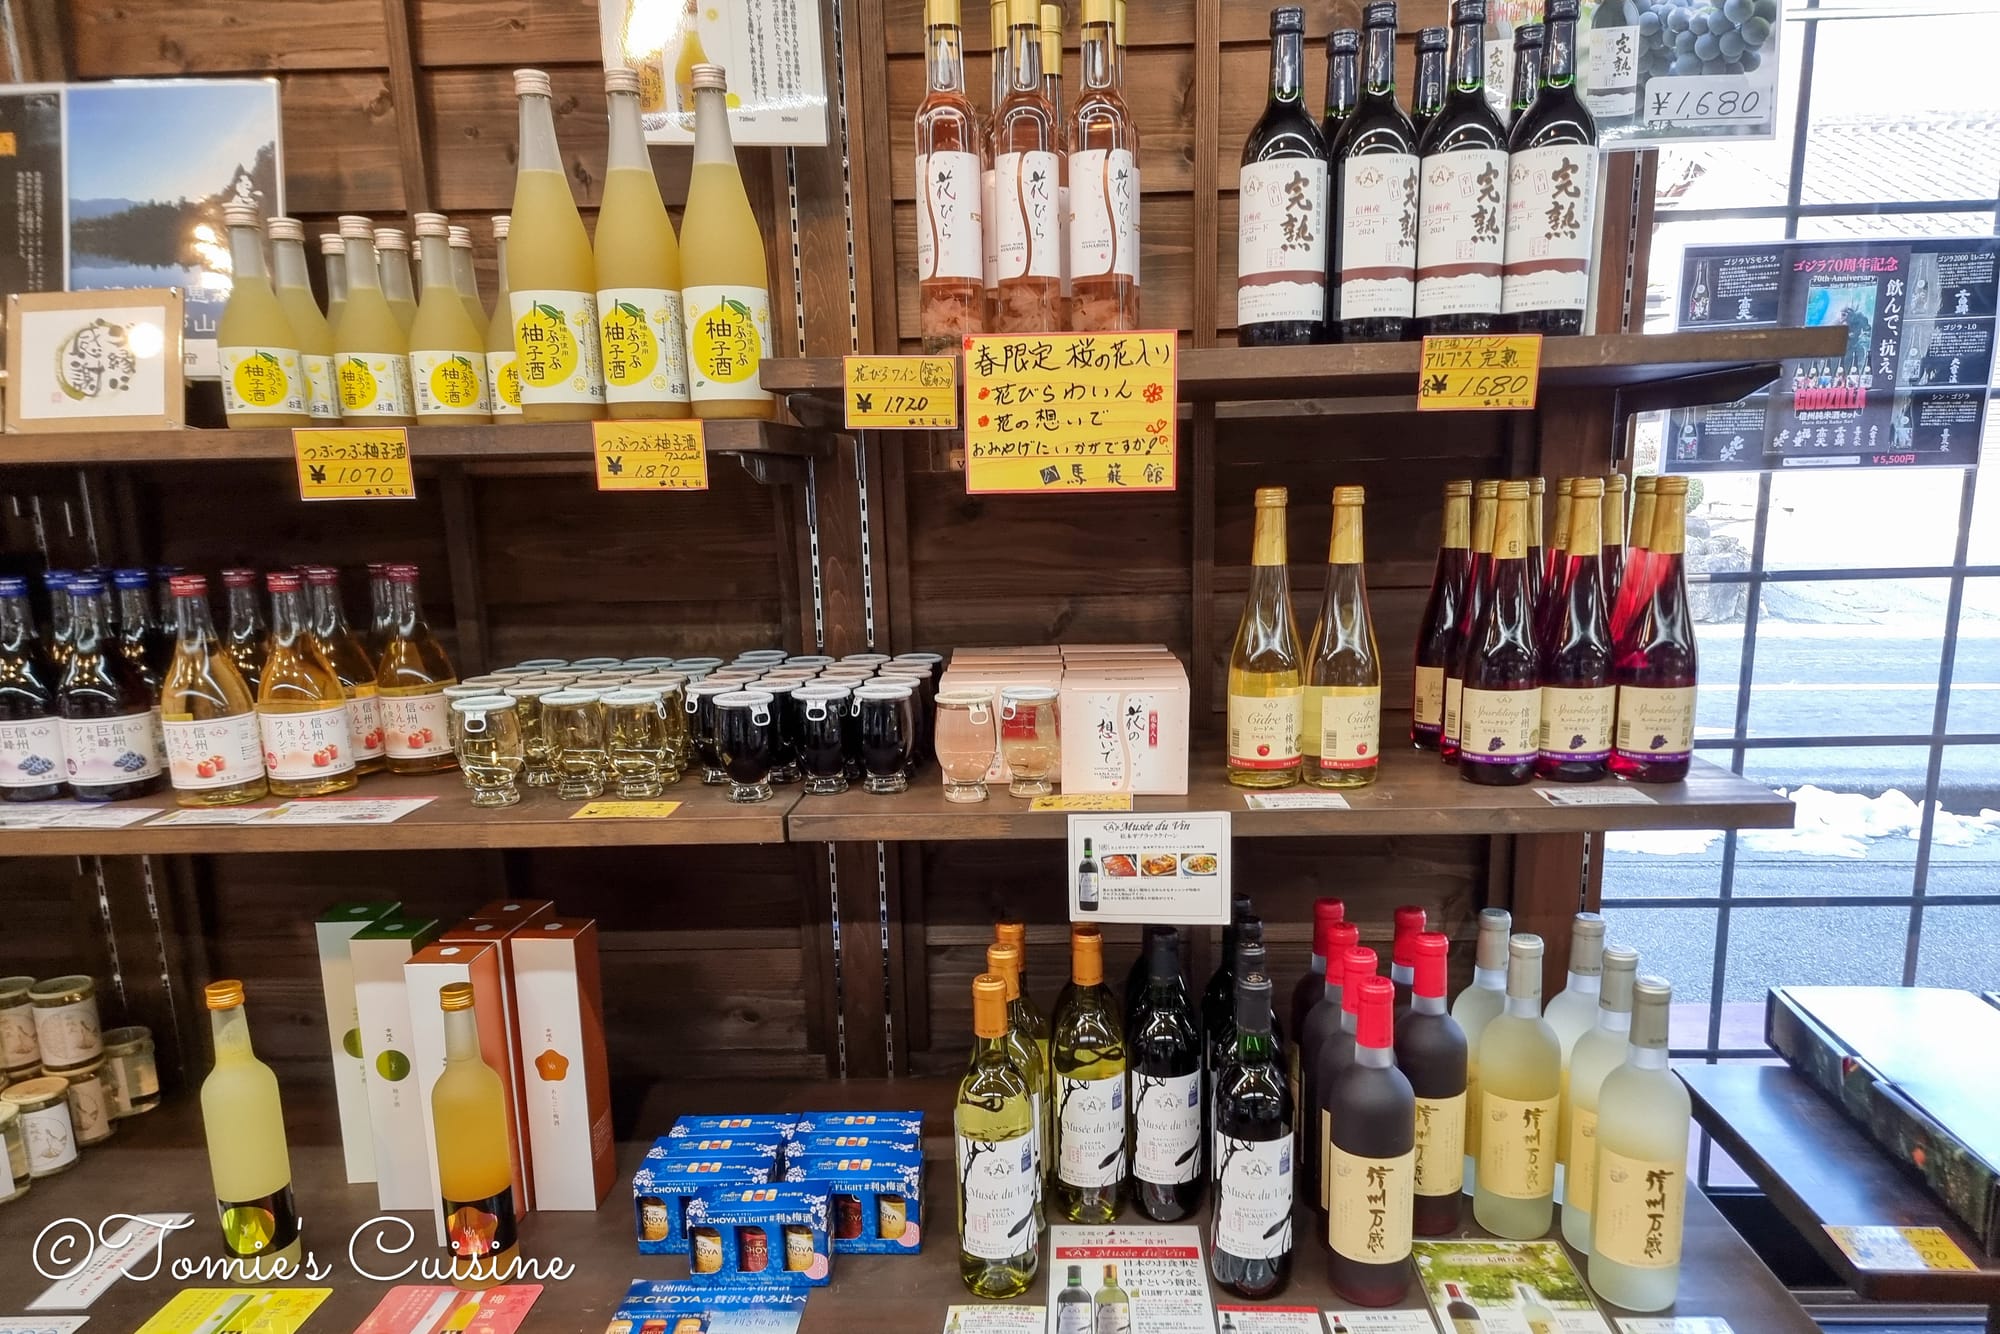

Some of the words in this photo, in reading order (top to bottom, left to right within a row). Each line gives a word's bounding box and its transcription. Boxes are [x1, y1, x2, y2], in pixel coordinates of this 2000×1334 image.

[1613, 33, 1632, 77] 完熟
[1651, 91, 1760, 119] ¥1,680
[936, 170, 956, 239] 花びら
[1031, 170, 1049, 239] 花びら
[1116, 169, 1131, 237] 花びら
[1399, 167, 1418, 249] 完熟
[1471, 162, 1499, 244] 完熟
[1545, 157, 1580, 240] 完熟
[1281, 170, 1313, 252] 完熟
[1724, 255, 1777, 266] ゴジラVSモスラ
[1793, 256, 1898, 272] ゴジラ70周年記念
[733, 312, 749, 366] つぶつぶ
[1879, 279, 1904, 380] 飲んで、抗え。
[522, 323, 545, 380] 柚子酒
[544, 317, 561, 370] つぶつぶ
[605, 322, 626, 379] 柚子酒
[625, 315, 642, 368] つぶつぶ
[706, 318, 732, 377] 柚子酒
[974, 342, 1060, 377] 春限定
[1066, 338, 1170, 368] 桜の花入り
[1425, 351, 1471, 369] アルプス
[1479, 348, 1519, 369] 完熟
[244, 363, 266, 402] 柚子酒
[853, 364, 917, 383] 花びらワイン
[341, 370, 357, 407] 柚子酒
[442, 367, 461, 404] 柚子酒
[670, 384, 686, 395] お酒
[992, 380, 1133, 406] 花びらわいん
[312, 403, 329, 414] お酒
[377, 402, 394, 413] お酒
[856, 393, 872, 413] ¥
[1795, 387, 1867, 410] GODZILLA
[994, 409, 1109, 433] 花の想いで
[304, 442, 406, 459] つぶつぶ柚子酒
[601, 434, 697, 451] つぶつぶ柚子酒
[310, 465, 326, 484] ¥
[606, 456, 623, 475] ¥
[1066, 463, 1165, 486] 馬籠館
[1125, 704, 1145, 741] 花の
[1247, 711, 1282, 724] Cidre
[1346, 711, 1376, 724] Cidre
[1474, 704, 1520, 718] Sparkling
[311, 718, 324, 746] 信州の
[1097, 718, 1117, 764] 想いで
[1120, 821, 1153, 831] Musée
[1155, 820, 1168, 831] du
[1172, 820, 1191, 831] Vin
[1063, 1121, 1091, 1134] Musée
[1094, 1122, 1104, 1134] du
[1142, 1118, 1167, 1130] Musée
[1170, 1118, 1181, 1130] du
[653, 1186, 682, 1194] CHOYA
[683, 1186, 699, 1194] FLI
[968, 1187, 998, 1200] Musée
[1001, 1187, 1013, 1200] du
[1224, 1184, 1255, 1200] Musée
[1258, 1188, 1271, 1200] du
[707, 1217, 737, 1225] CHOYA
[738, 1215, 767, 1224] FLIGHT
[770, 1212, 813, 1224] #利き梅酒
[1095, 1247, 1138, 1258] Musée
[1142, 1247, 1158, 1258] du
[1162, 1247, 1186, 1258] Vin
[1123, 1260, 1198, 1268] 日本のお食事と
[1124, 1269, 1196, 1277] 日本のワインを
[1125, 1278, 1202, 1287] 食すという贅沢。
